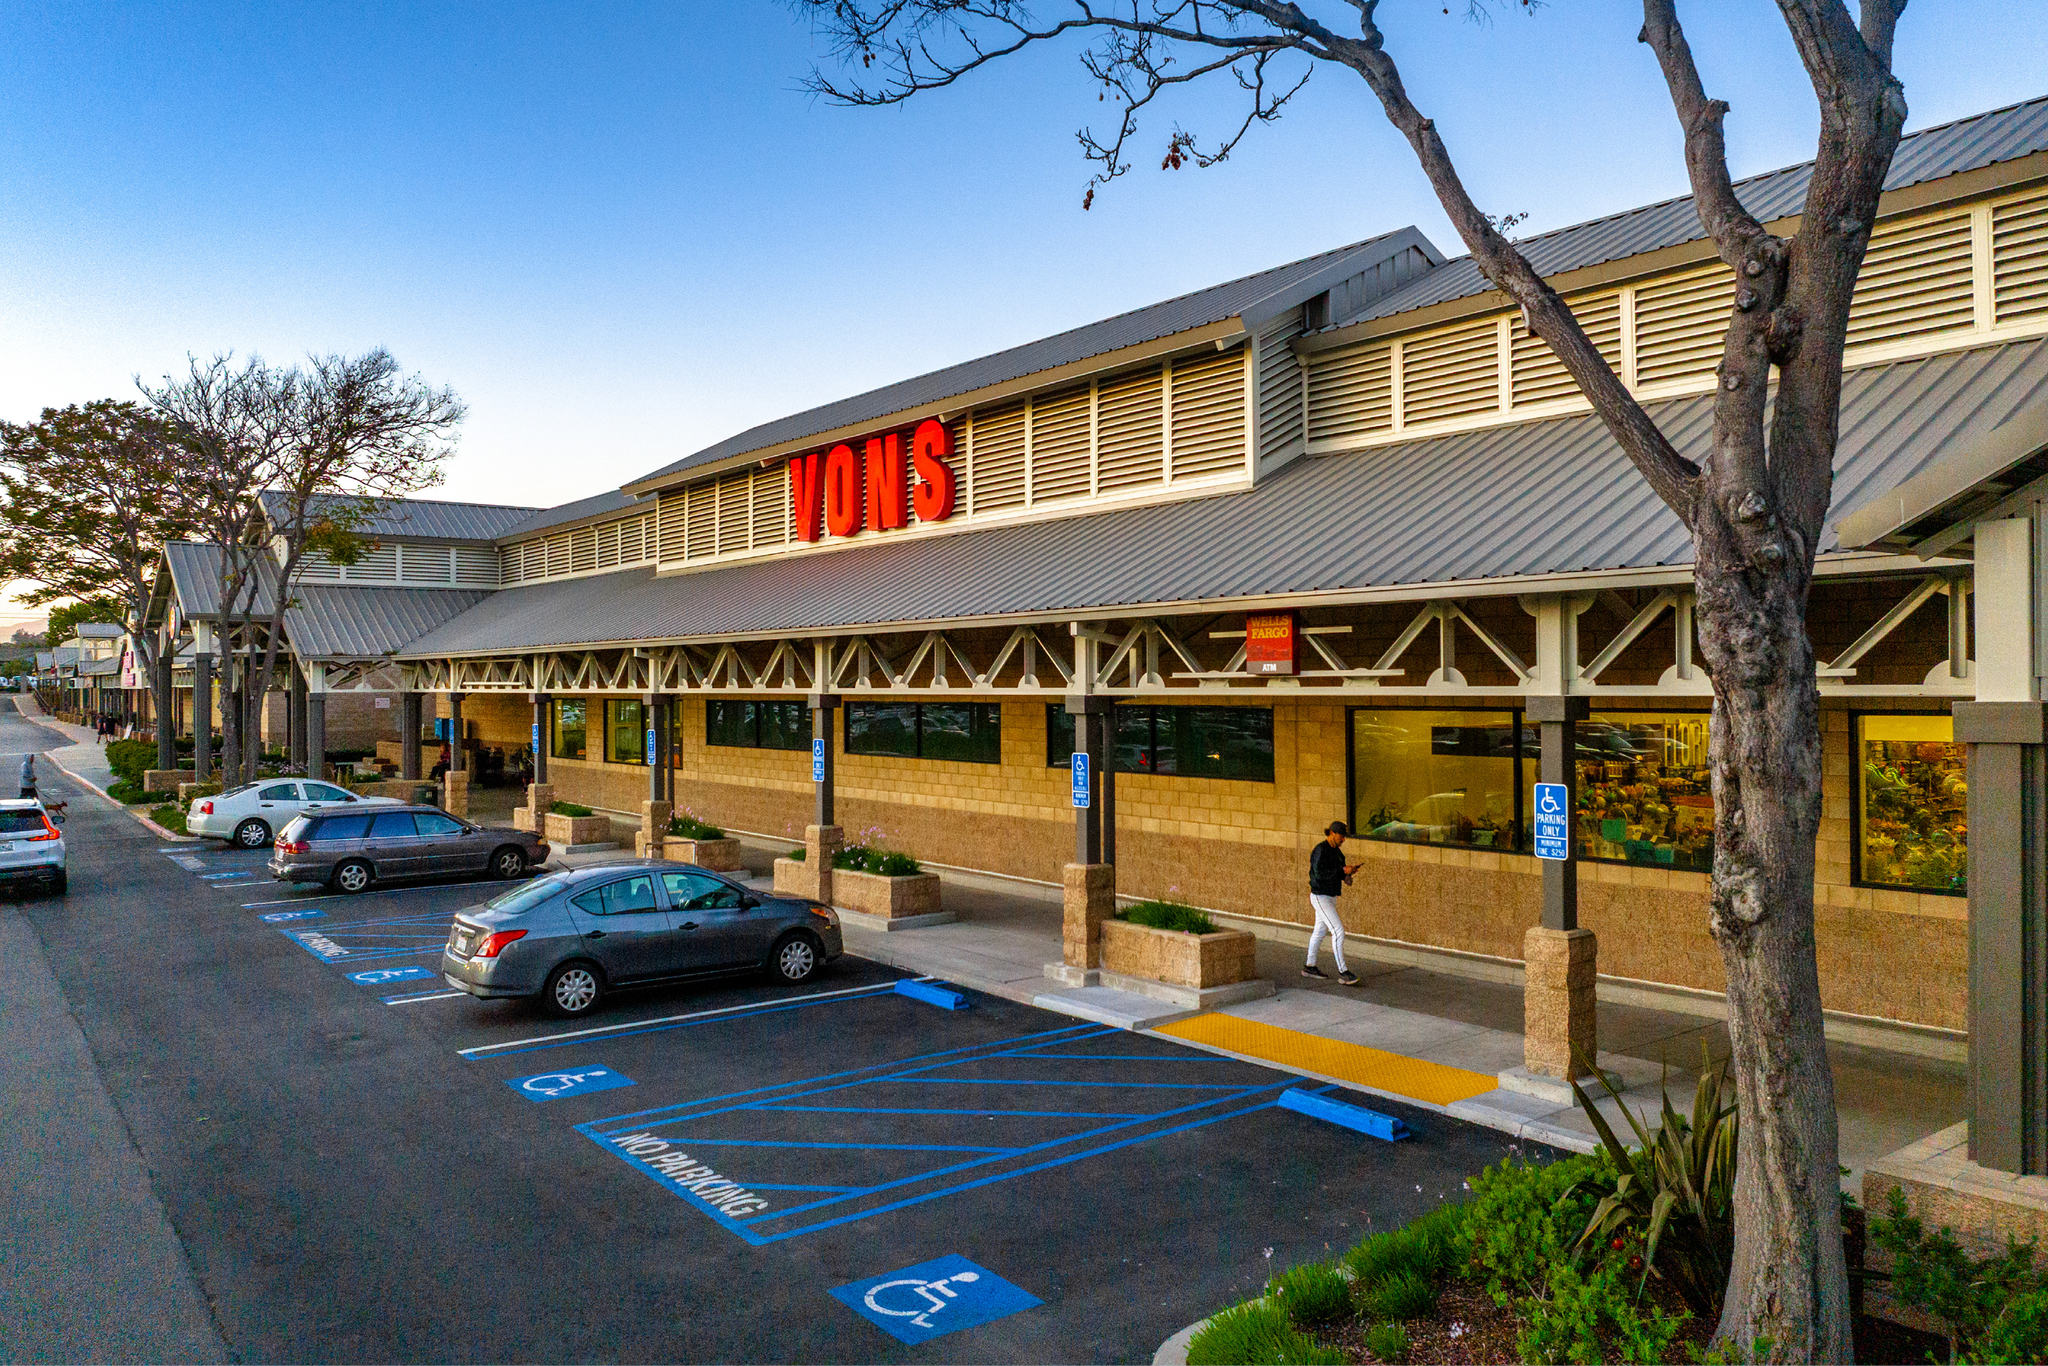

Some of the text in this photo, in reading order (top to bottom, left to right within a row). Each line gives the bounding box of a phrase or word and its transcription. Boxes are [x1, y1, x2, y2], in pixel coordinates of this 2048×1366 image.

[790, 419, 956, 542] VONS
[1251, 615, 1289, 627] WELLS
[1251, 627, 1289, 639] FARGO
[1262, 663, 1277, 672] ATM
[1536, 813, 1566, 826] PARKING
[1542, 825, 1560, 836] ONLY
[1541, 840, 1561, 848] MINIMUM
[1537, 847, 1566, 857] FINE $250
[611, 1132, 769, 1217] NO PARKING
